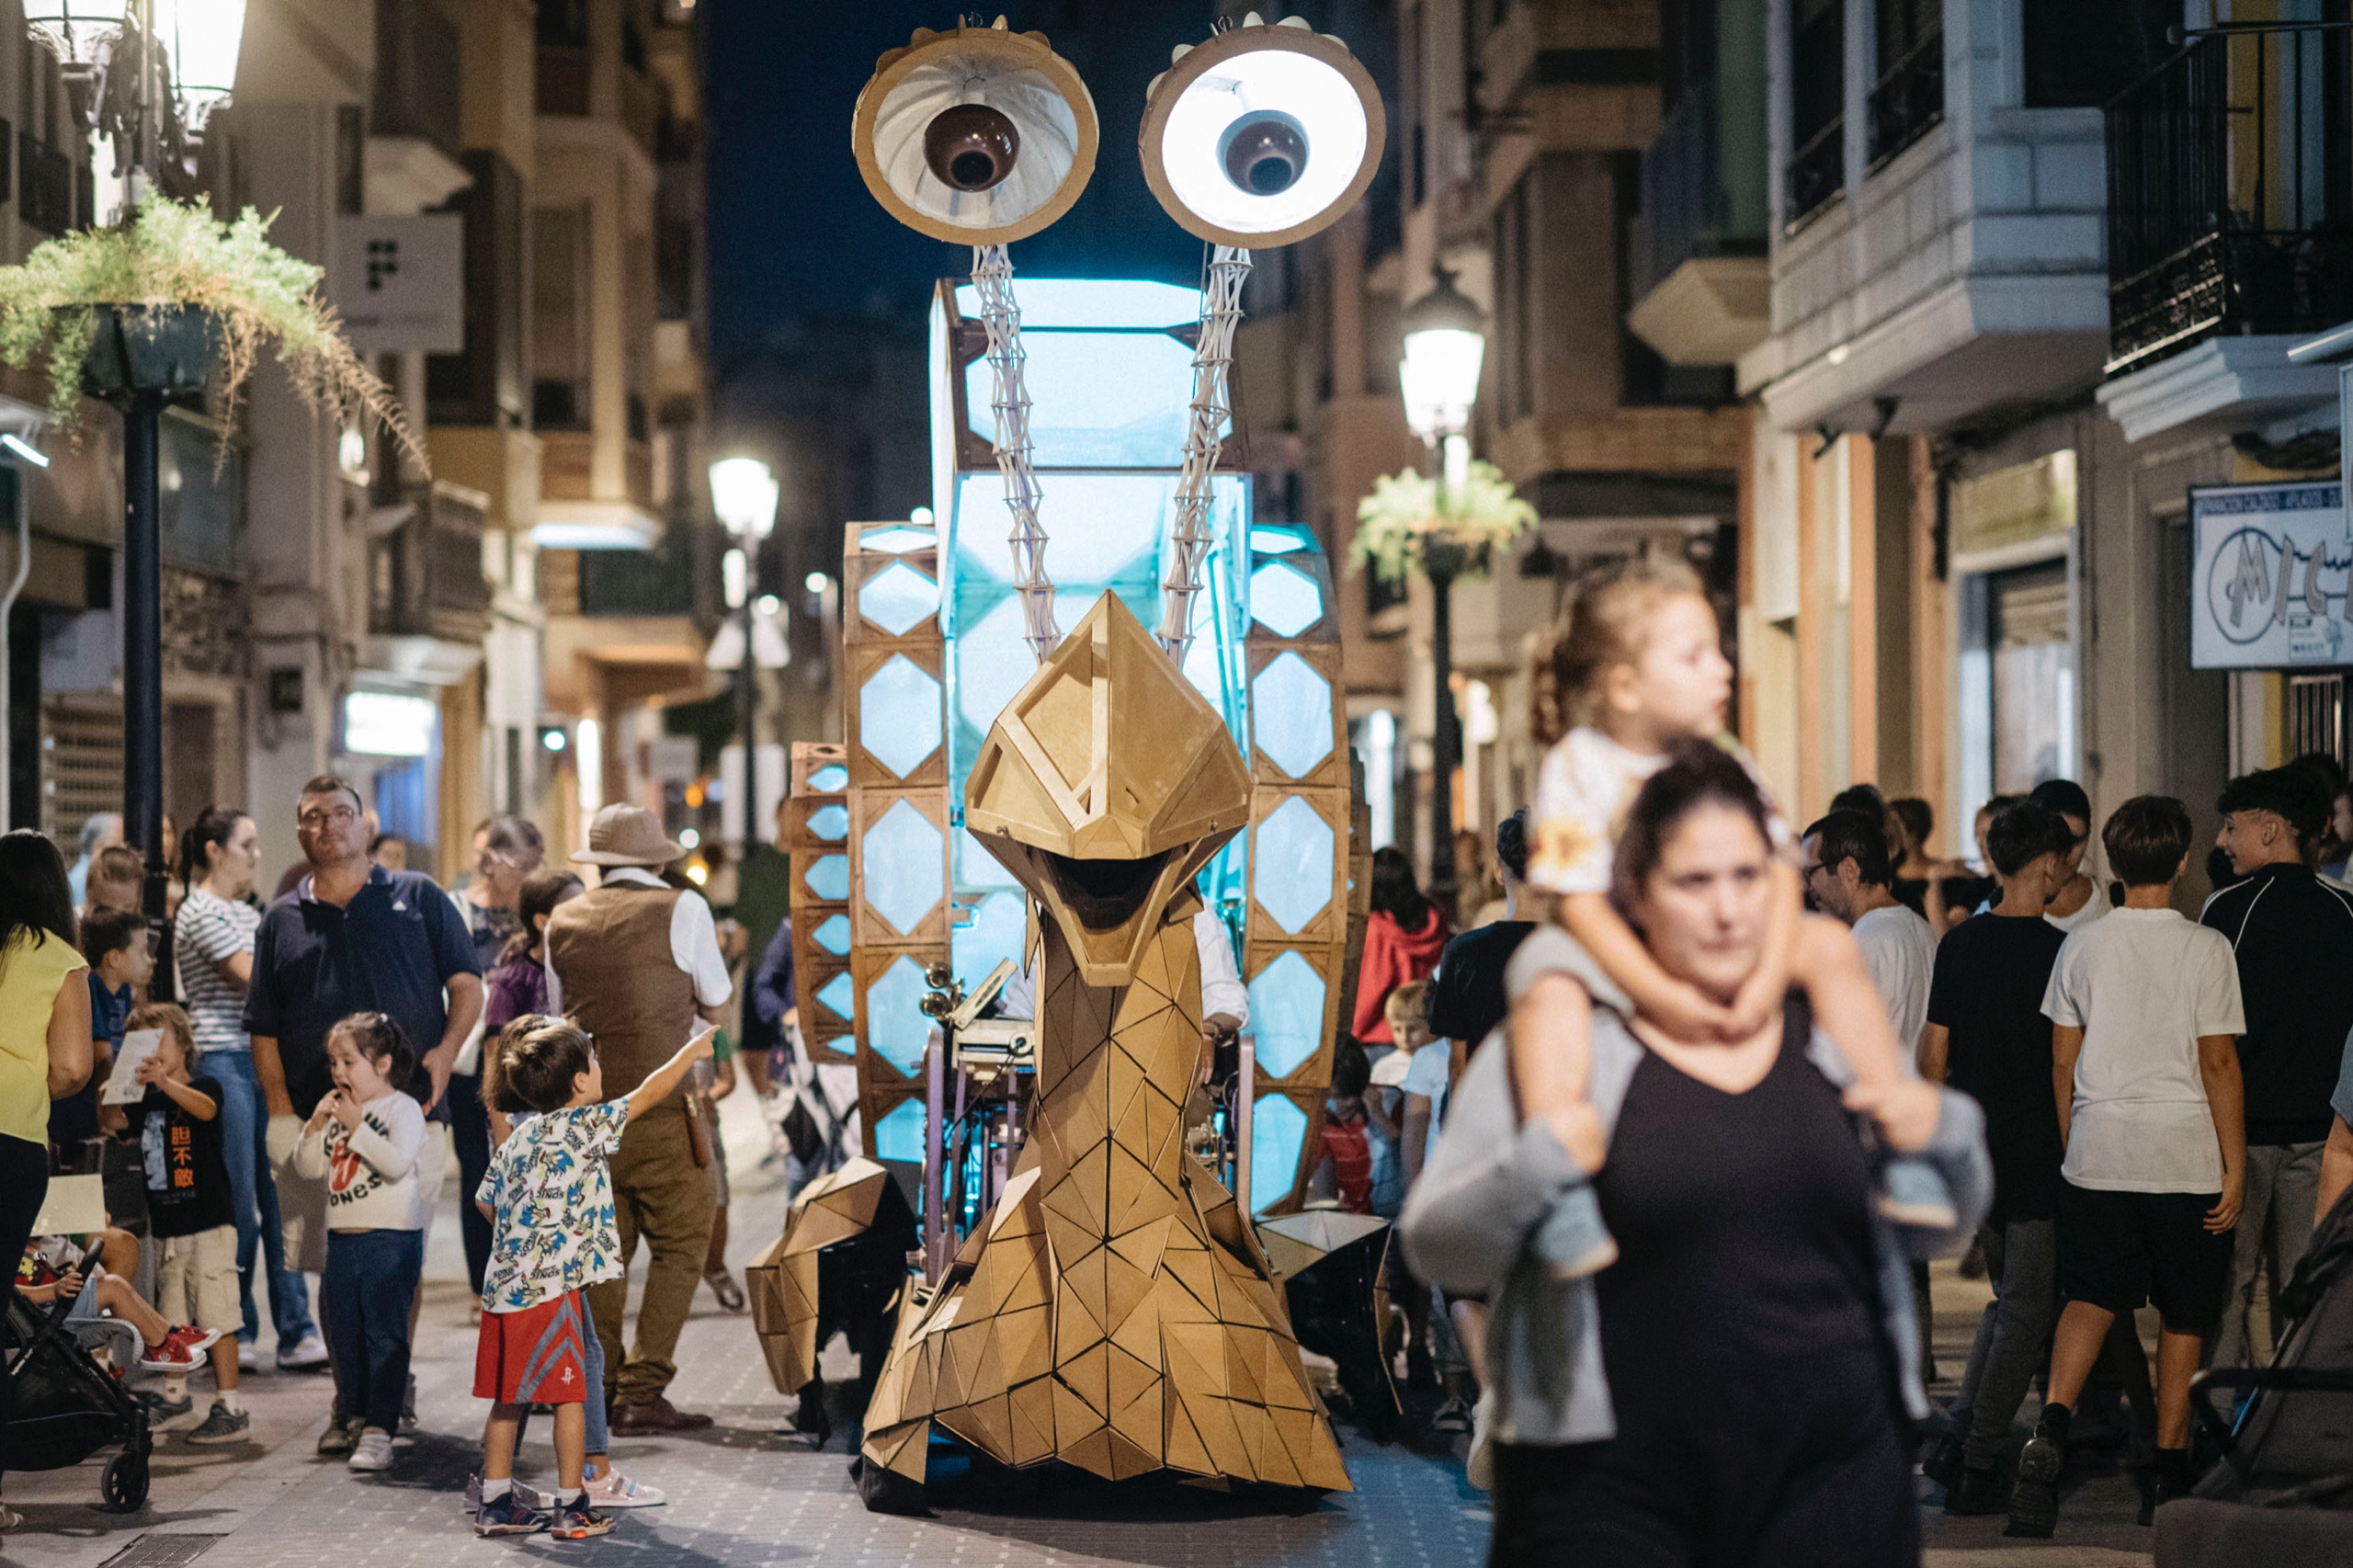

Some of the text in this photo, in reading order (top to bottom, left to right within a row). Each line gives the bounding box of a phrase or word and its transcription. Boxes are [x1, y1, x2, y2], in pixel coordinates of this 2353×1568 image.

[564, 1126, 585, 1148] SONIC
[536, 1189, 563, 1199] SONIC
[597, 1227, 617, 1250] SONIC
[529, 1268, 560, 1279] SONIC
